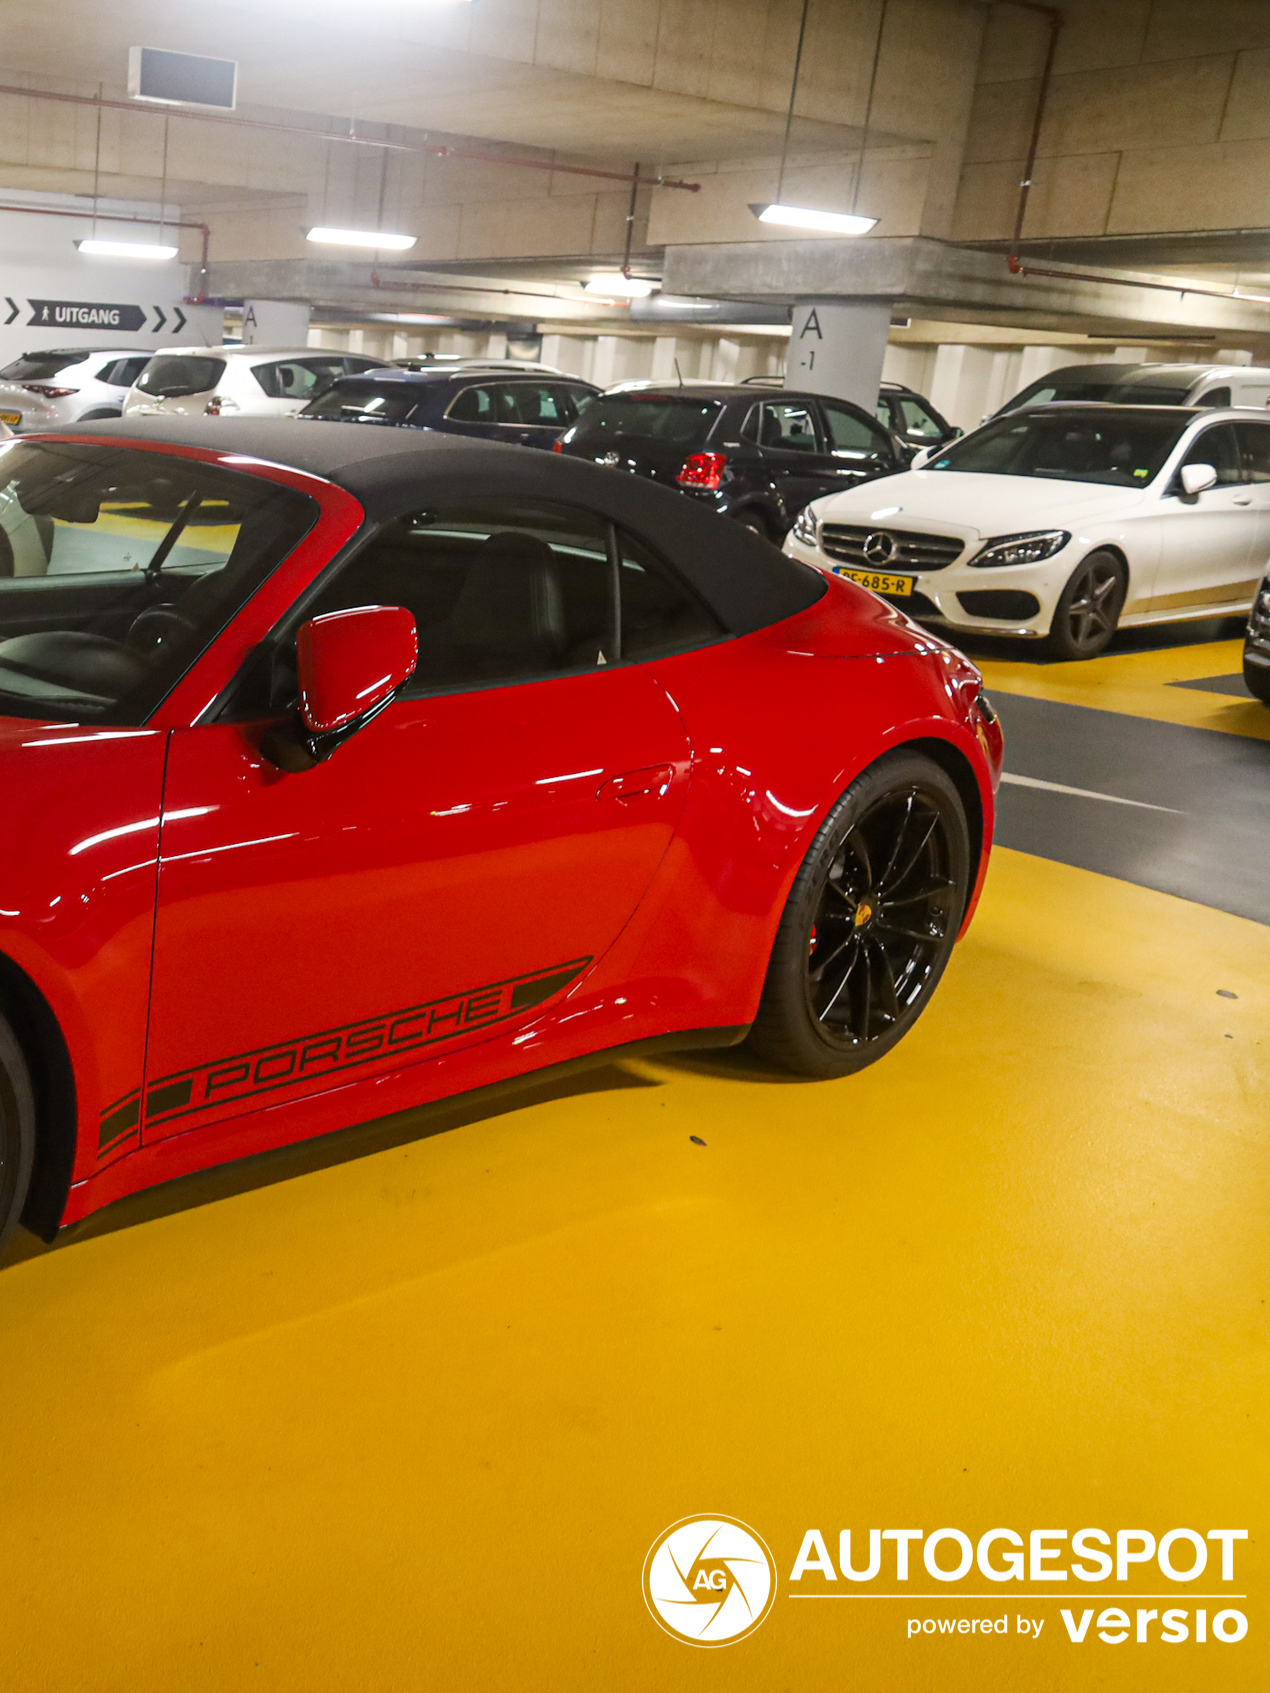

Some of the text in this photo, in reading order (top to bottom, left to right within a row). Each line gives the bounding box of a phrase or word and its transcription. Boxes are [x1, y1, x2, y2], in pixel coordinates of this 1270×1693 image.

[55, 306, 120, 325] UITGANG
[244, 305, 257, 327] A
[800, 307, 822, 339] A
[800, 350, 815, 370] -1
[205, 990, 503, 1099] PORSCHE
